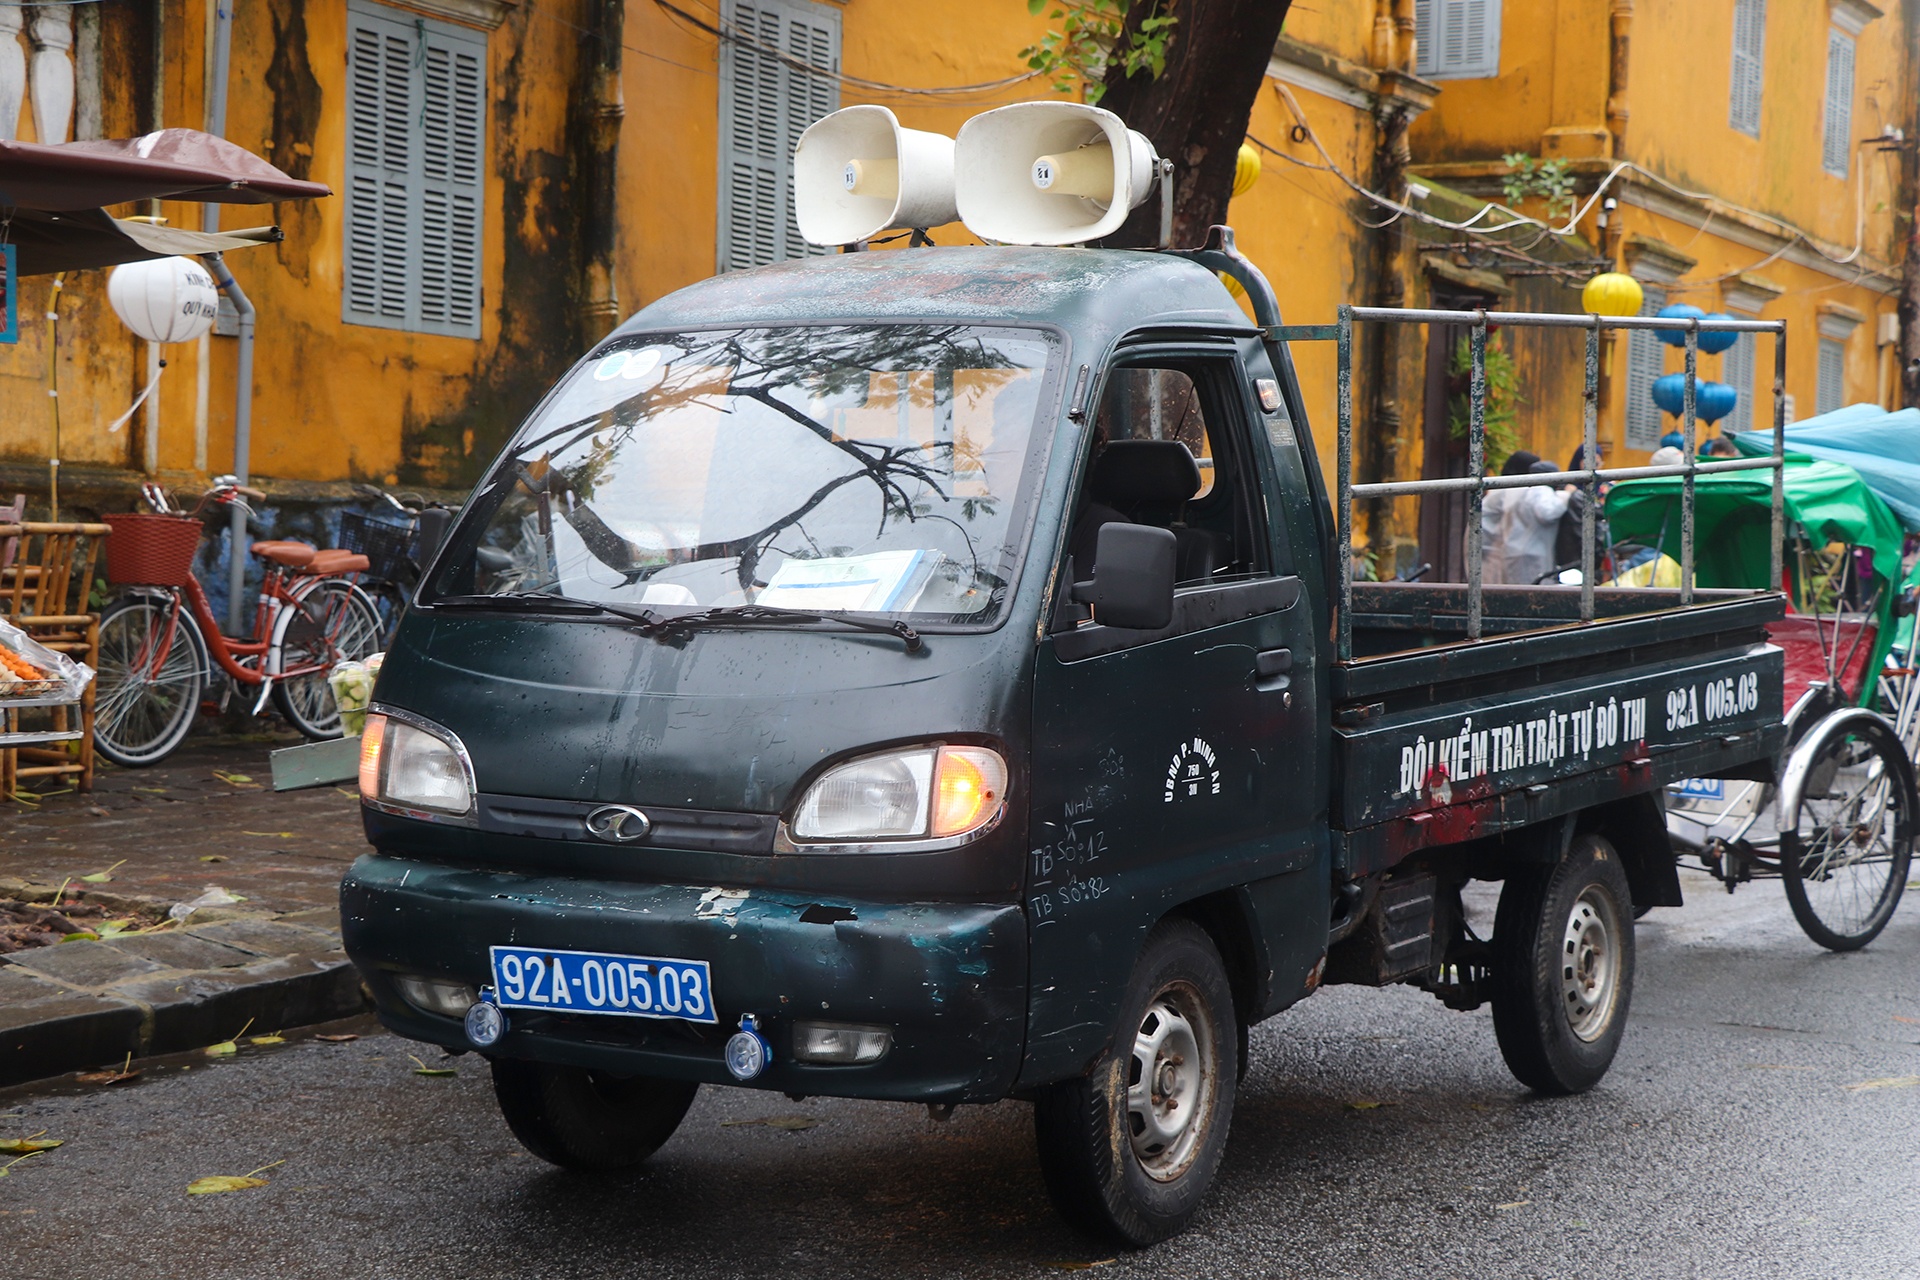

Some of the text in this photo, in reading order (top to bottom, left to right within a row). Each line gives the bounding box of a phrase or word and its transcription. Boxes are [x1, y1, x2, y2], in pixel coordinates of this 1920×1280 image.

[183, 299, 202, 316] QUÝ
[1666, 672, 1759, 732] 92A 005.03
[1164, 737, 1220, 802] UBND P. MINH AN
[1187, 763, 1200, 777] 750
[1400, 697, 1647, 800] ĐỘI KIỂM TRA TRẬT TỰ ĐÔ THỊ
[1032, 845, 1053, 877] TB
[1031, 894, 1053, 918] TB
[501, 954, 705, 1016] 92A-005.03
